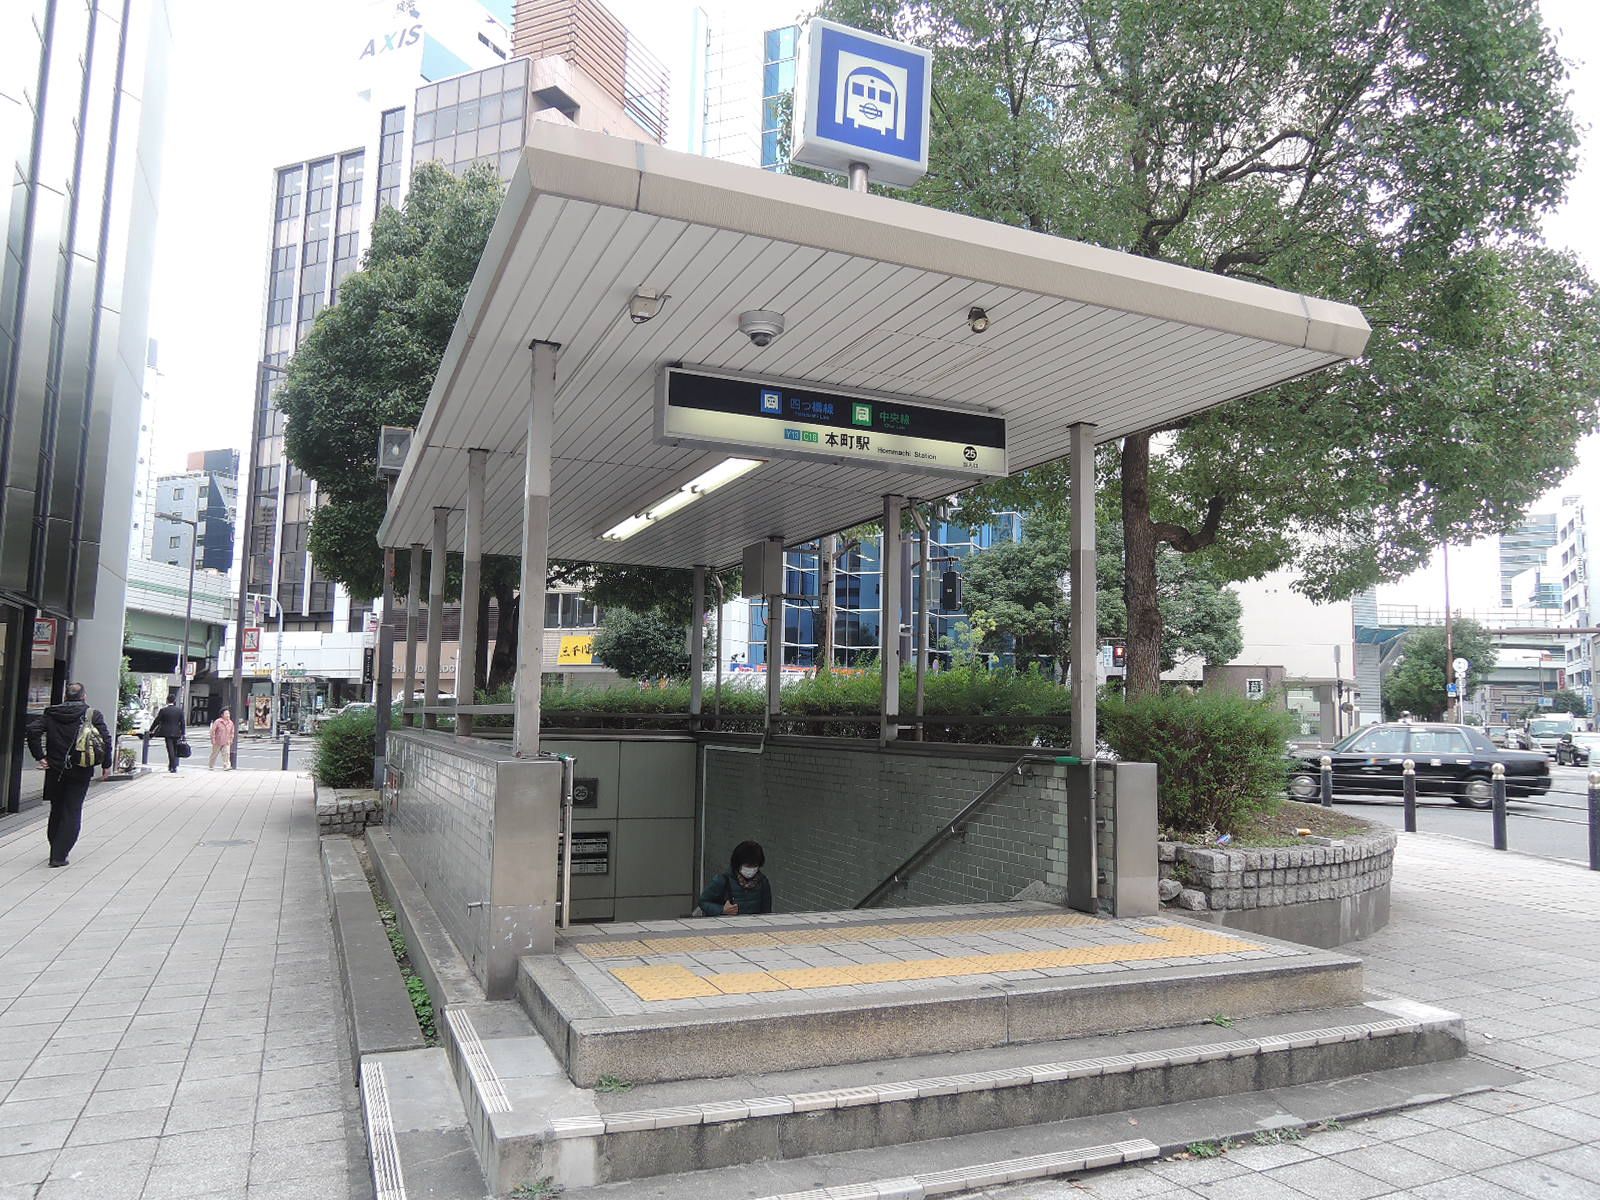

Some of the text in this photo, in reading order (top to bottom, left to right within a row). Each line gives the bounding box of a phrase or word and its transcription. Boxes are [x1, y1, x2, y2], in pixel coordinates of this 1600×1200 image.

[359, 24, 423, 60] AXIS
[787, 431, 799, 440] Y13
[825, 432, 870, 450] 本町駅
[914, 451, 937, 460] Station
[964, 449, 976, 458] 25
[575, 788, 587, 797] 25
